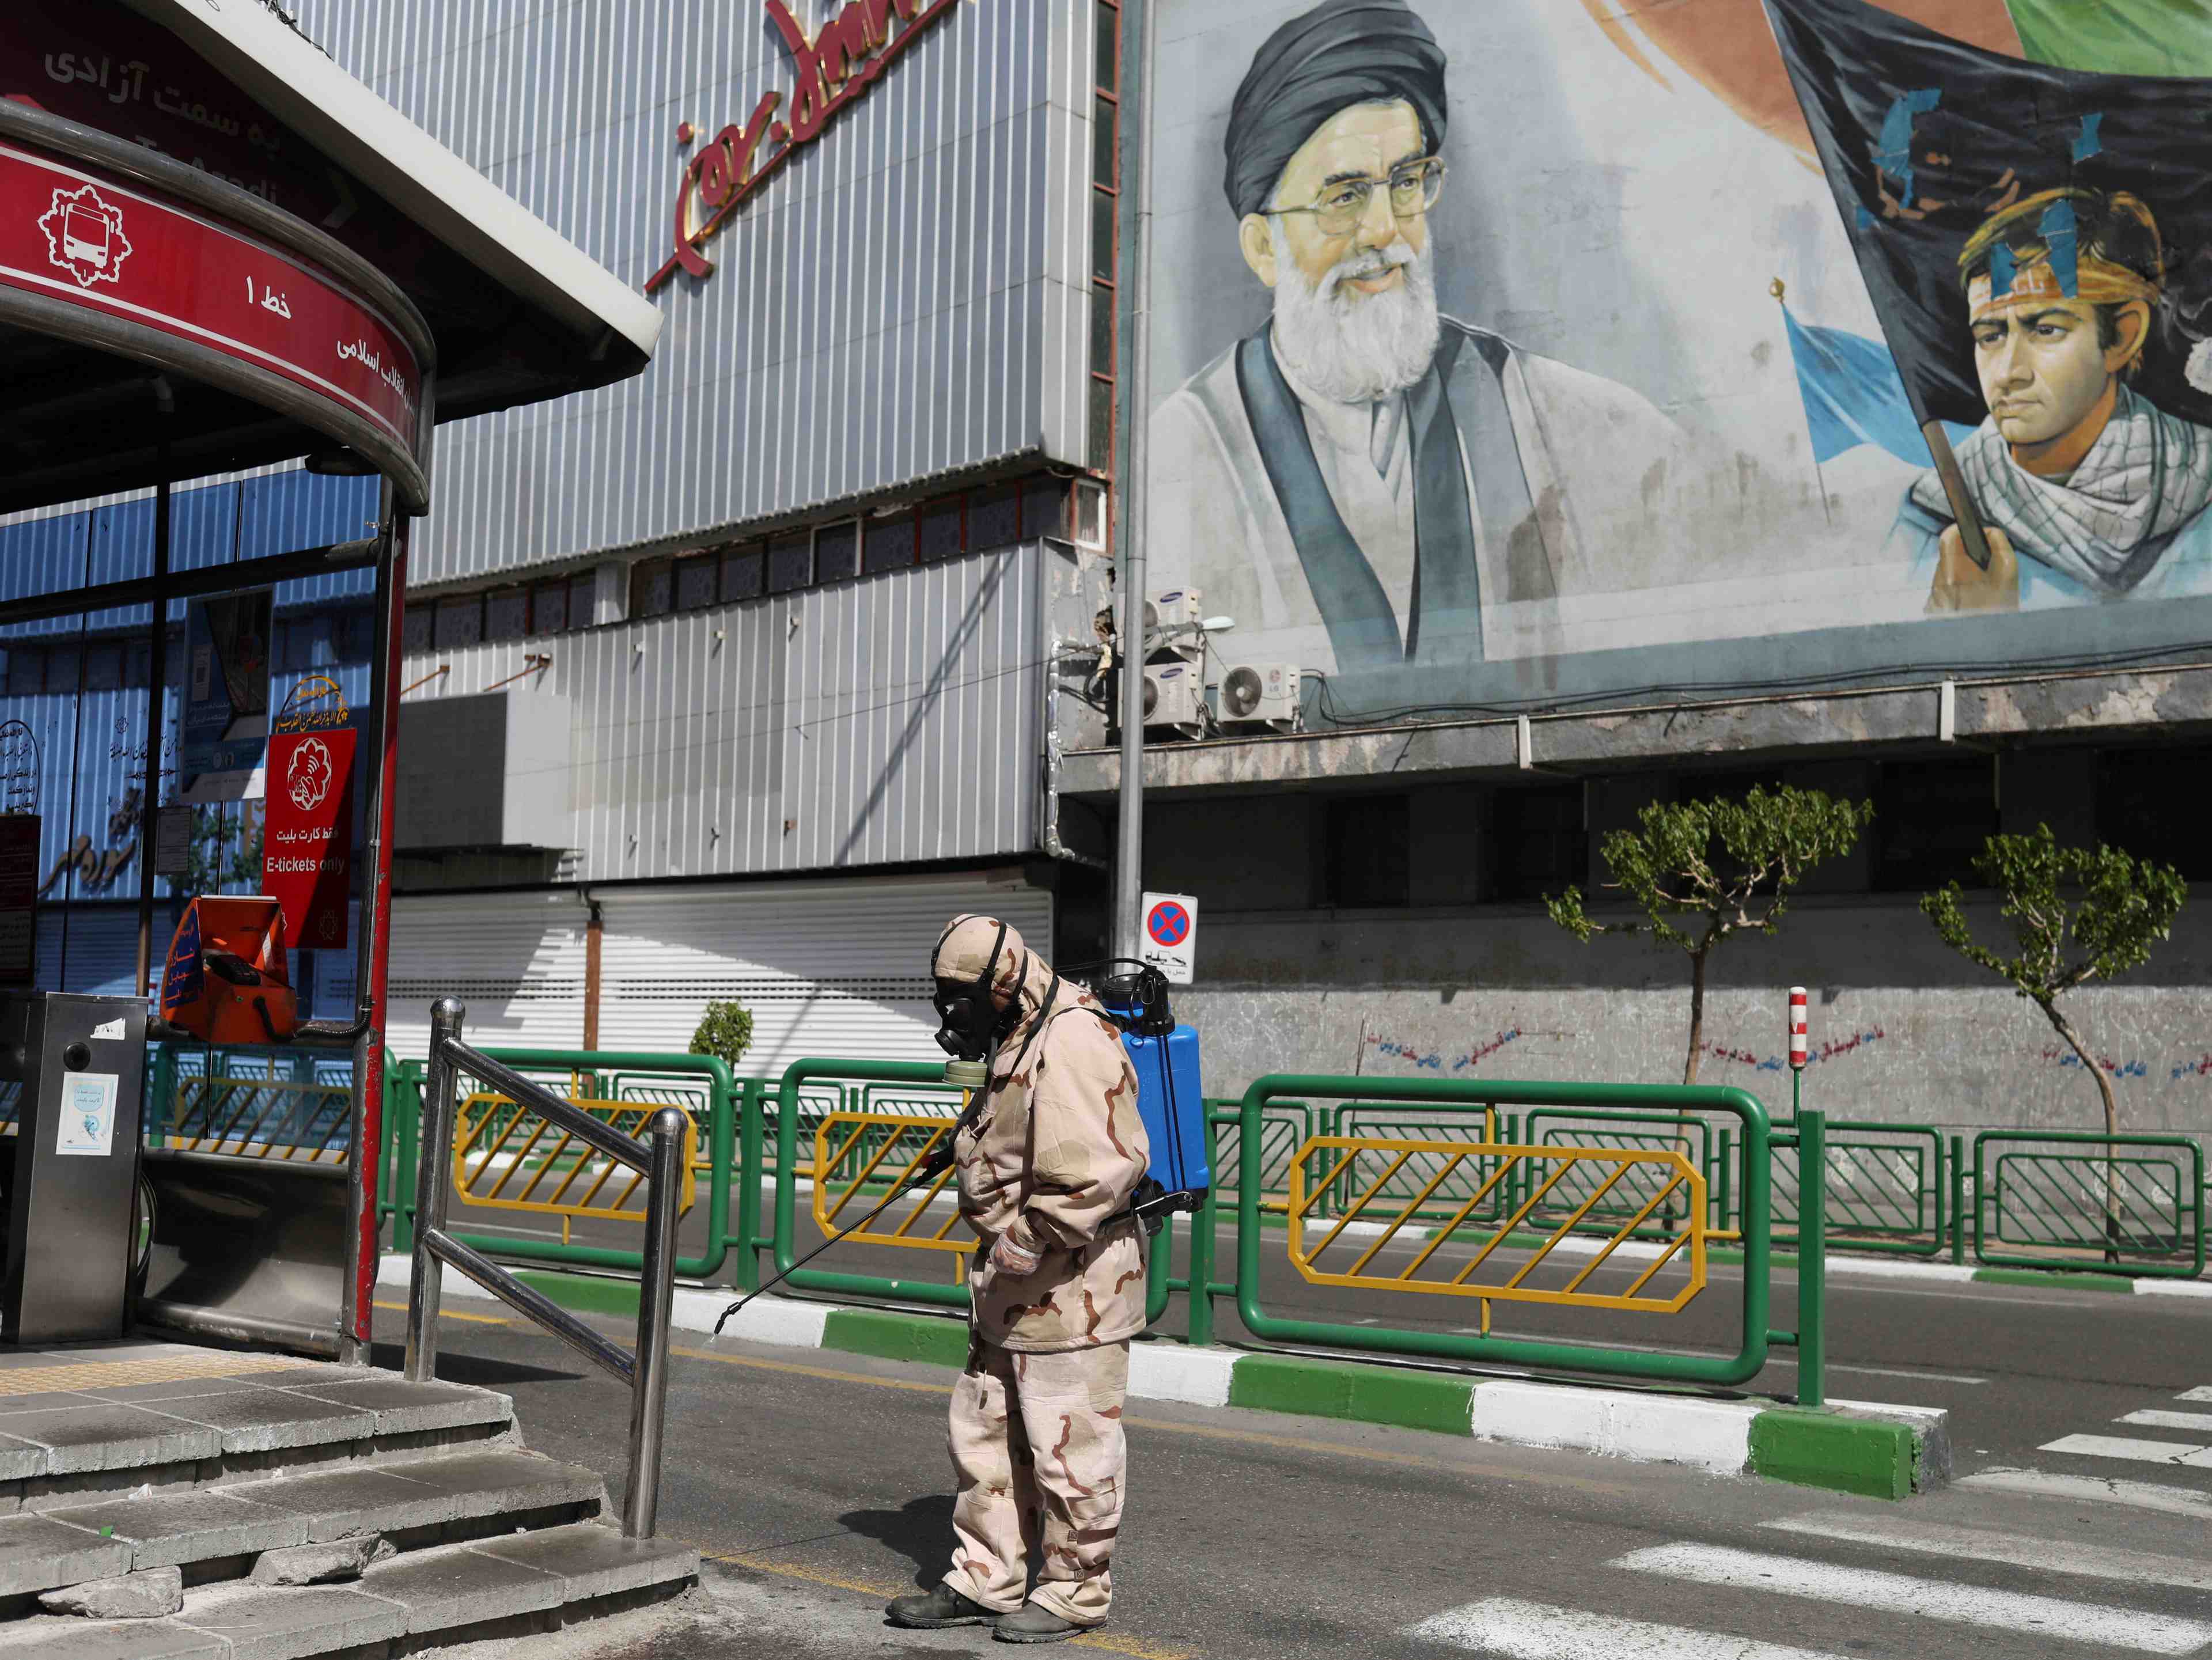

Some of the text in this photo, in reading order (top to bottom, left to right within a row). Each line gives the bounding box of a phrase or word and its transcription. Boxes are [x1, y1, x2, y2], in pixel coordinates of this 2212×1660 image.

[44, 52, 281, 161] به سمت آزادی
[260, 285, 291, 319] خط
[336, 338, 380, 373] اسلامی
[381, 365, 404, 398] انقلاب
[276, 825, 339, 844] فقط کارت بلیت
[267, 856, 346, 876] E-tickets only
